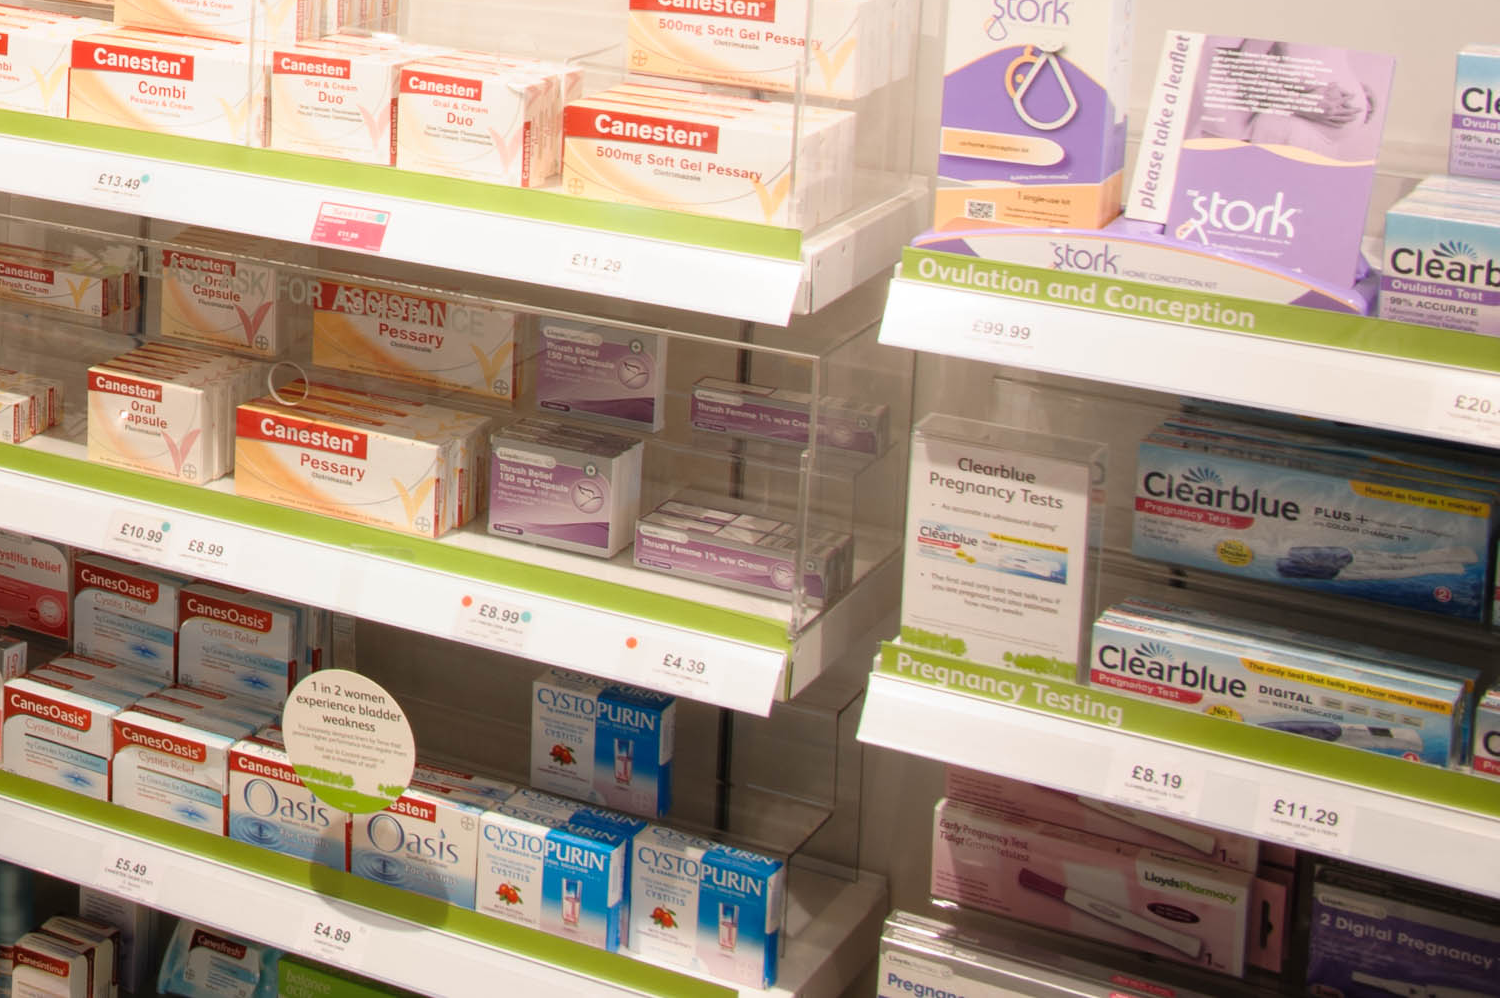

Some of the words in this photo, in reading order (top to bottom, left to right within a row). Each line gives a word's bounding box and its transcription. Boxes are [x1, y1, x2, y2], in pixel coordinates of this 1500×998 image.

[93, 47, 181, 75] Canesten
[595, 114, 704, 147] Canesten
[1139, 155, 1163, 210] please
[1155, 105, 1173, 149] take
[1165, 35, 1190, 88] leaflet
[596, 146, 643, 164] 500mg
[647, 153, 675, 169] Soft
[679, 159, 703, 173] Gel
[707, 162, 763, 184] Pessary
[1190, 191, 1295, 238] stork
[918, 258, 1040, 294] Ovulation
[1048, 282, 1096, 304] and
[1105, 286, 1255, 328] Conception
[1392, 279, 1452, 296] Ovulation
[1456, 288, 1483, 301] Test
[1416, 300, 1478, 316] ACCURATE
[972, 319, 1031, 340] £99.99
[261, 417, 356, 454] Canesten
[300, 453, 366, 482] Pessary
[958, 458, 1036, 483] Clearblue
[930, 472, 1015, 502] Pregnancy
[1021, 489, 1064, 509] Tests
[1143, 472, 1300, 521] Clearblue
[1314, 507, 1351, 521] PLUS
[120, 523, 163, 544] £10.99
[187, 539, 224, 558] £8.99
[479, 604, 520, 625] £8.99
[663, 653, 706, 675] £4.39
[1099, 644, 1246, 698] Clearblue
[321, 683, 331, 693] in
[335, 685, 341, 696] 2
[345, 690, 385, 704] women
[896, 654, 1026, 704] Pregnancy
[1030, 684, 1124, 728] Testing
[1259, 685, 1313, 704] DIGITAL
[11, 693, 85, 727] CanesOasis
[296, 695, 355, 713] experience
[359, 706, 401, 722] bladder
[322, 714, 376, 732] weakness
[538, 686, 658, 733] CYSTOPURIN
[1131, 764, 1182, 790] £8.19
[1273, 798, 1339, 828] £11.29
[368, 813, 459, 864] Oasis
[483, 823, 607, 873] CYSTOPURIN
[116, 857, 148, 876] £5.49
[1144, 870, 1238, 905] LloydsPharmacy
[314, 921, 351, 945] £4.89
[1335, 918, 1392, 944] Digital
[1396, 932, 1494, 971] Pregnancy
